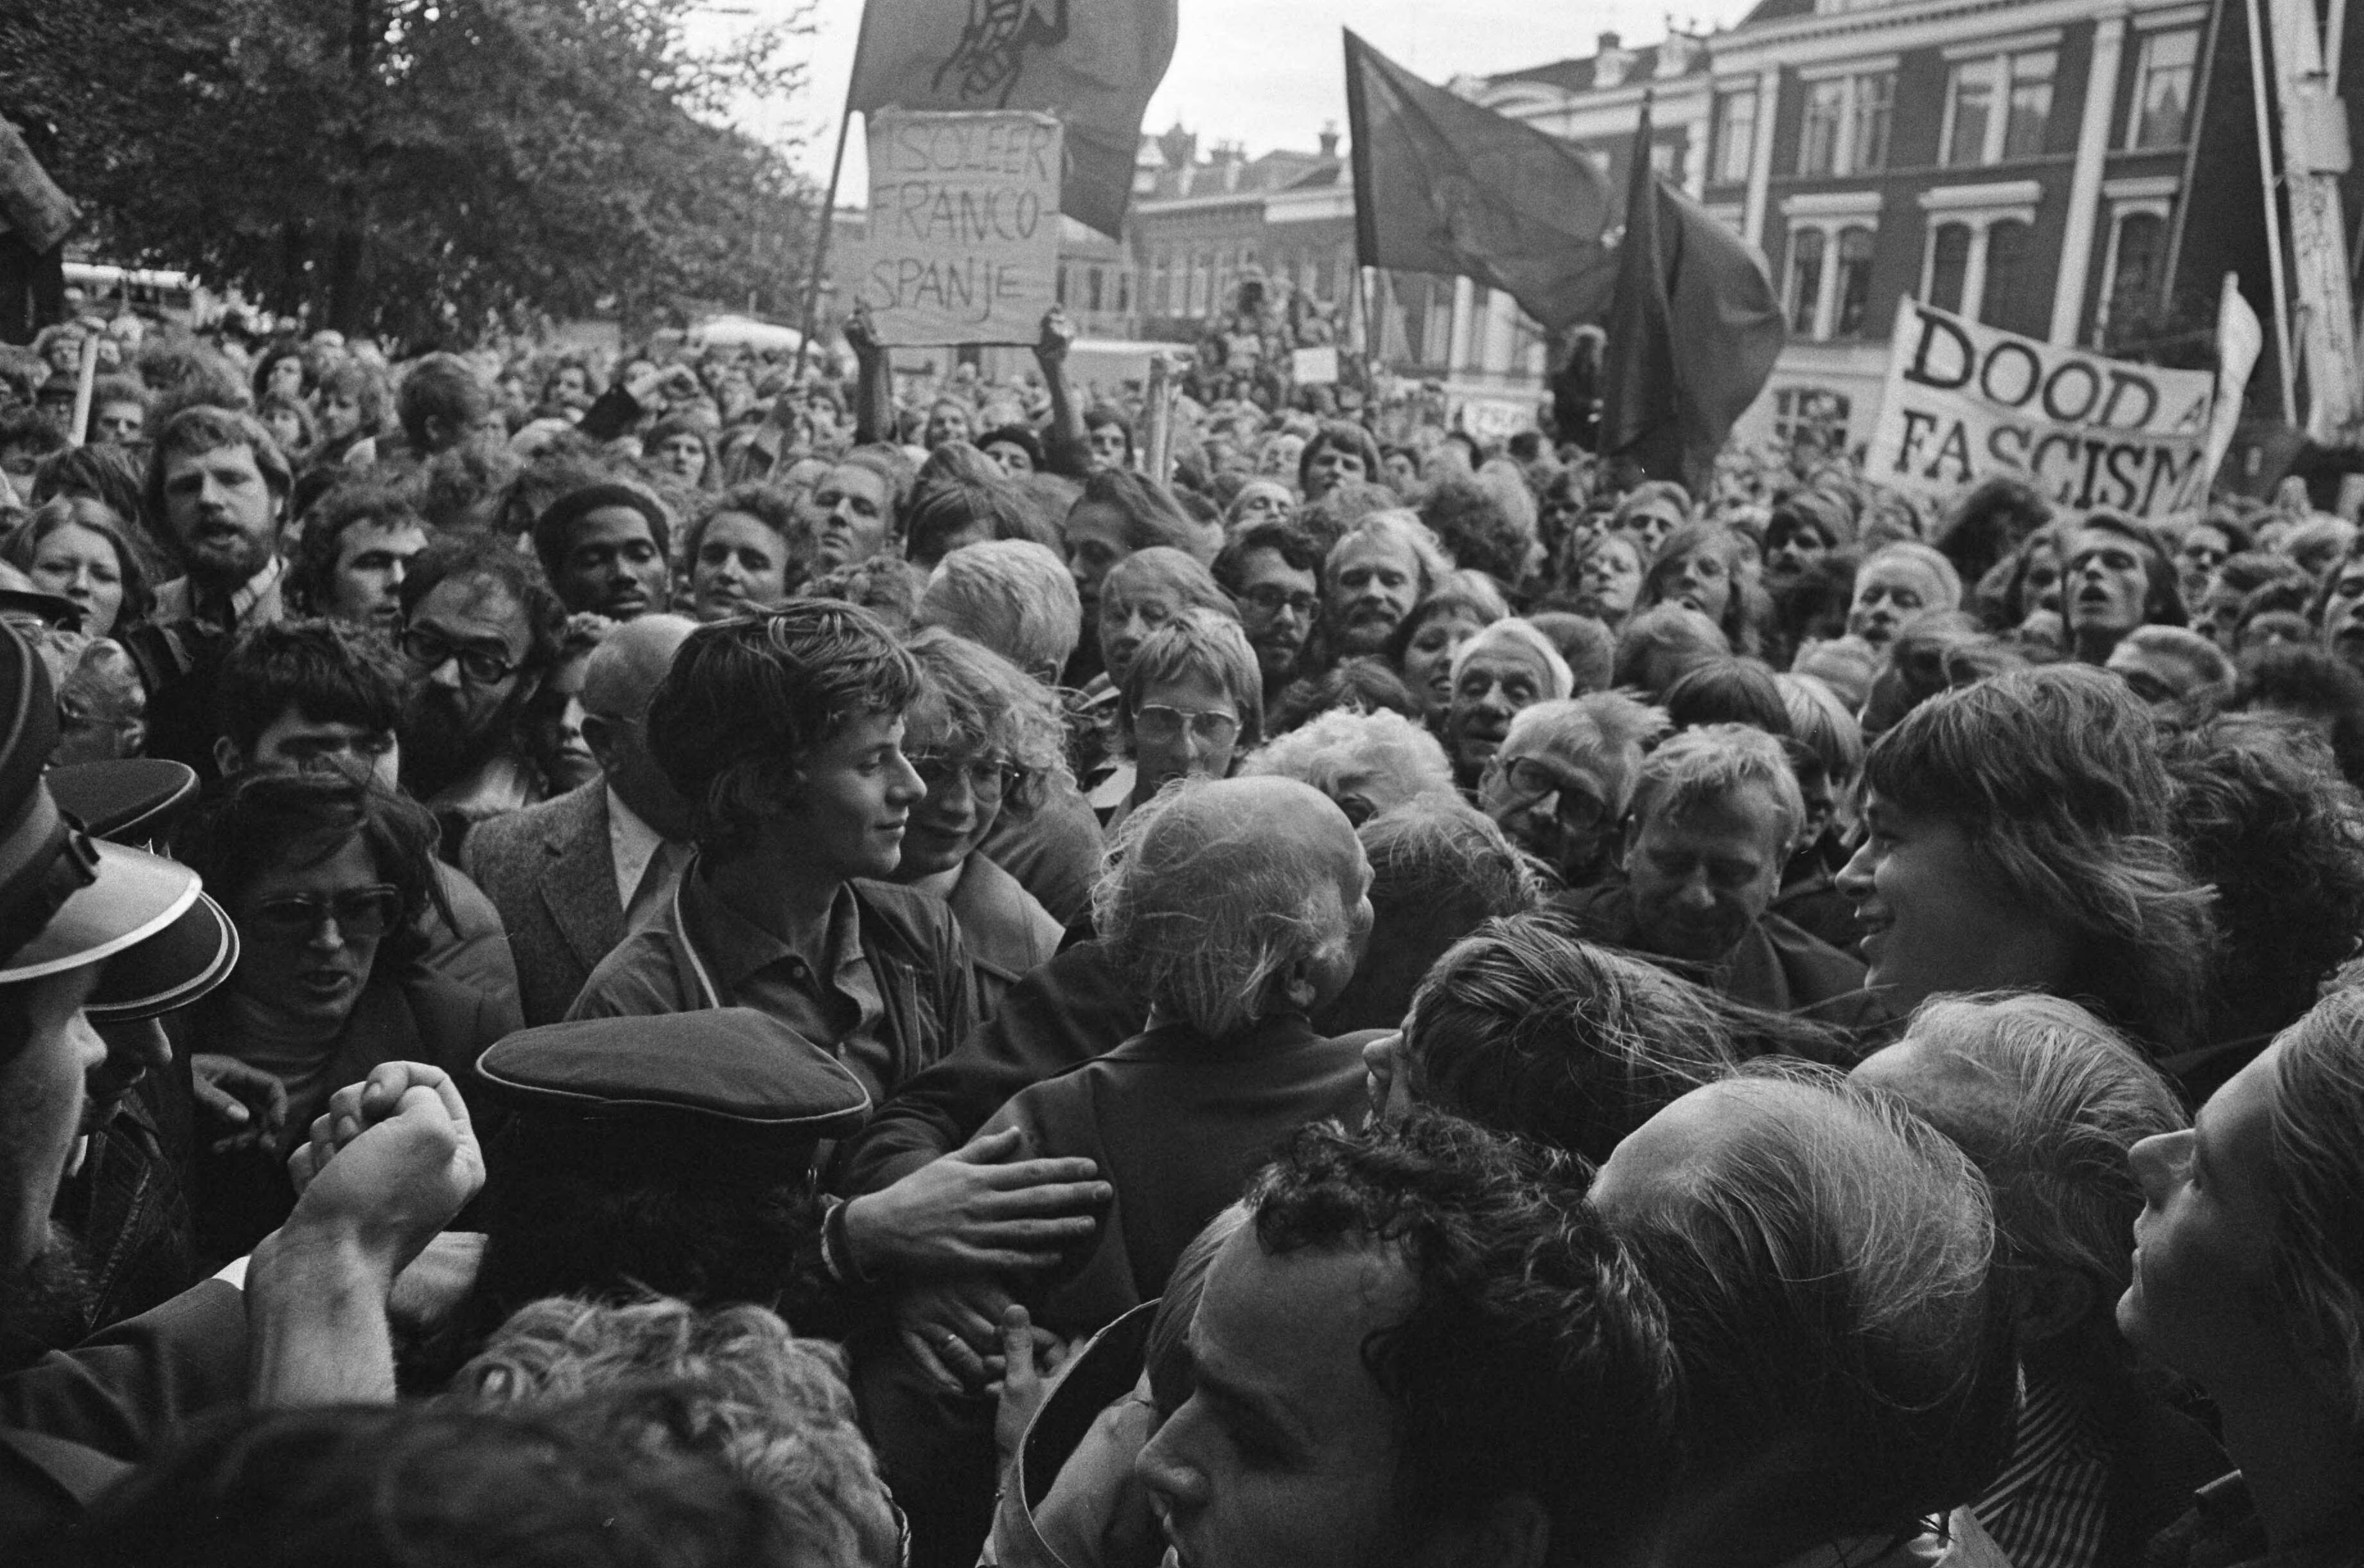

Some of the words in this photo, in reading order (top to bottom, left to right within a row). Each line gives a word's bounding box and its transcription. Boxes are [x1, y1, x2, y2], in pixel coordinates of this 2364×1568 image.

[885, 121, 1055, 181] ISOLEER
[871, 181, 1039, 242] FRANCO
[869, 258, 1024, 322] SPANJE
[1903, 308, 2158, 429] DOOD
